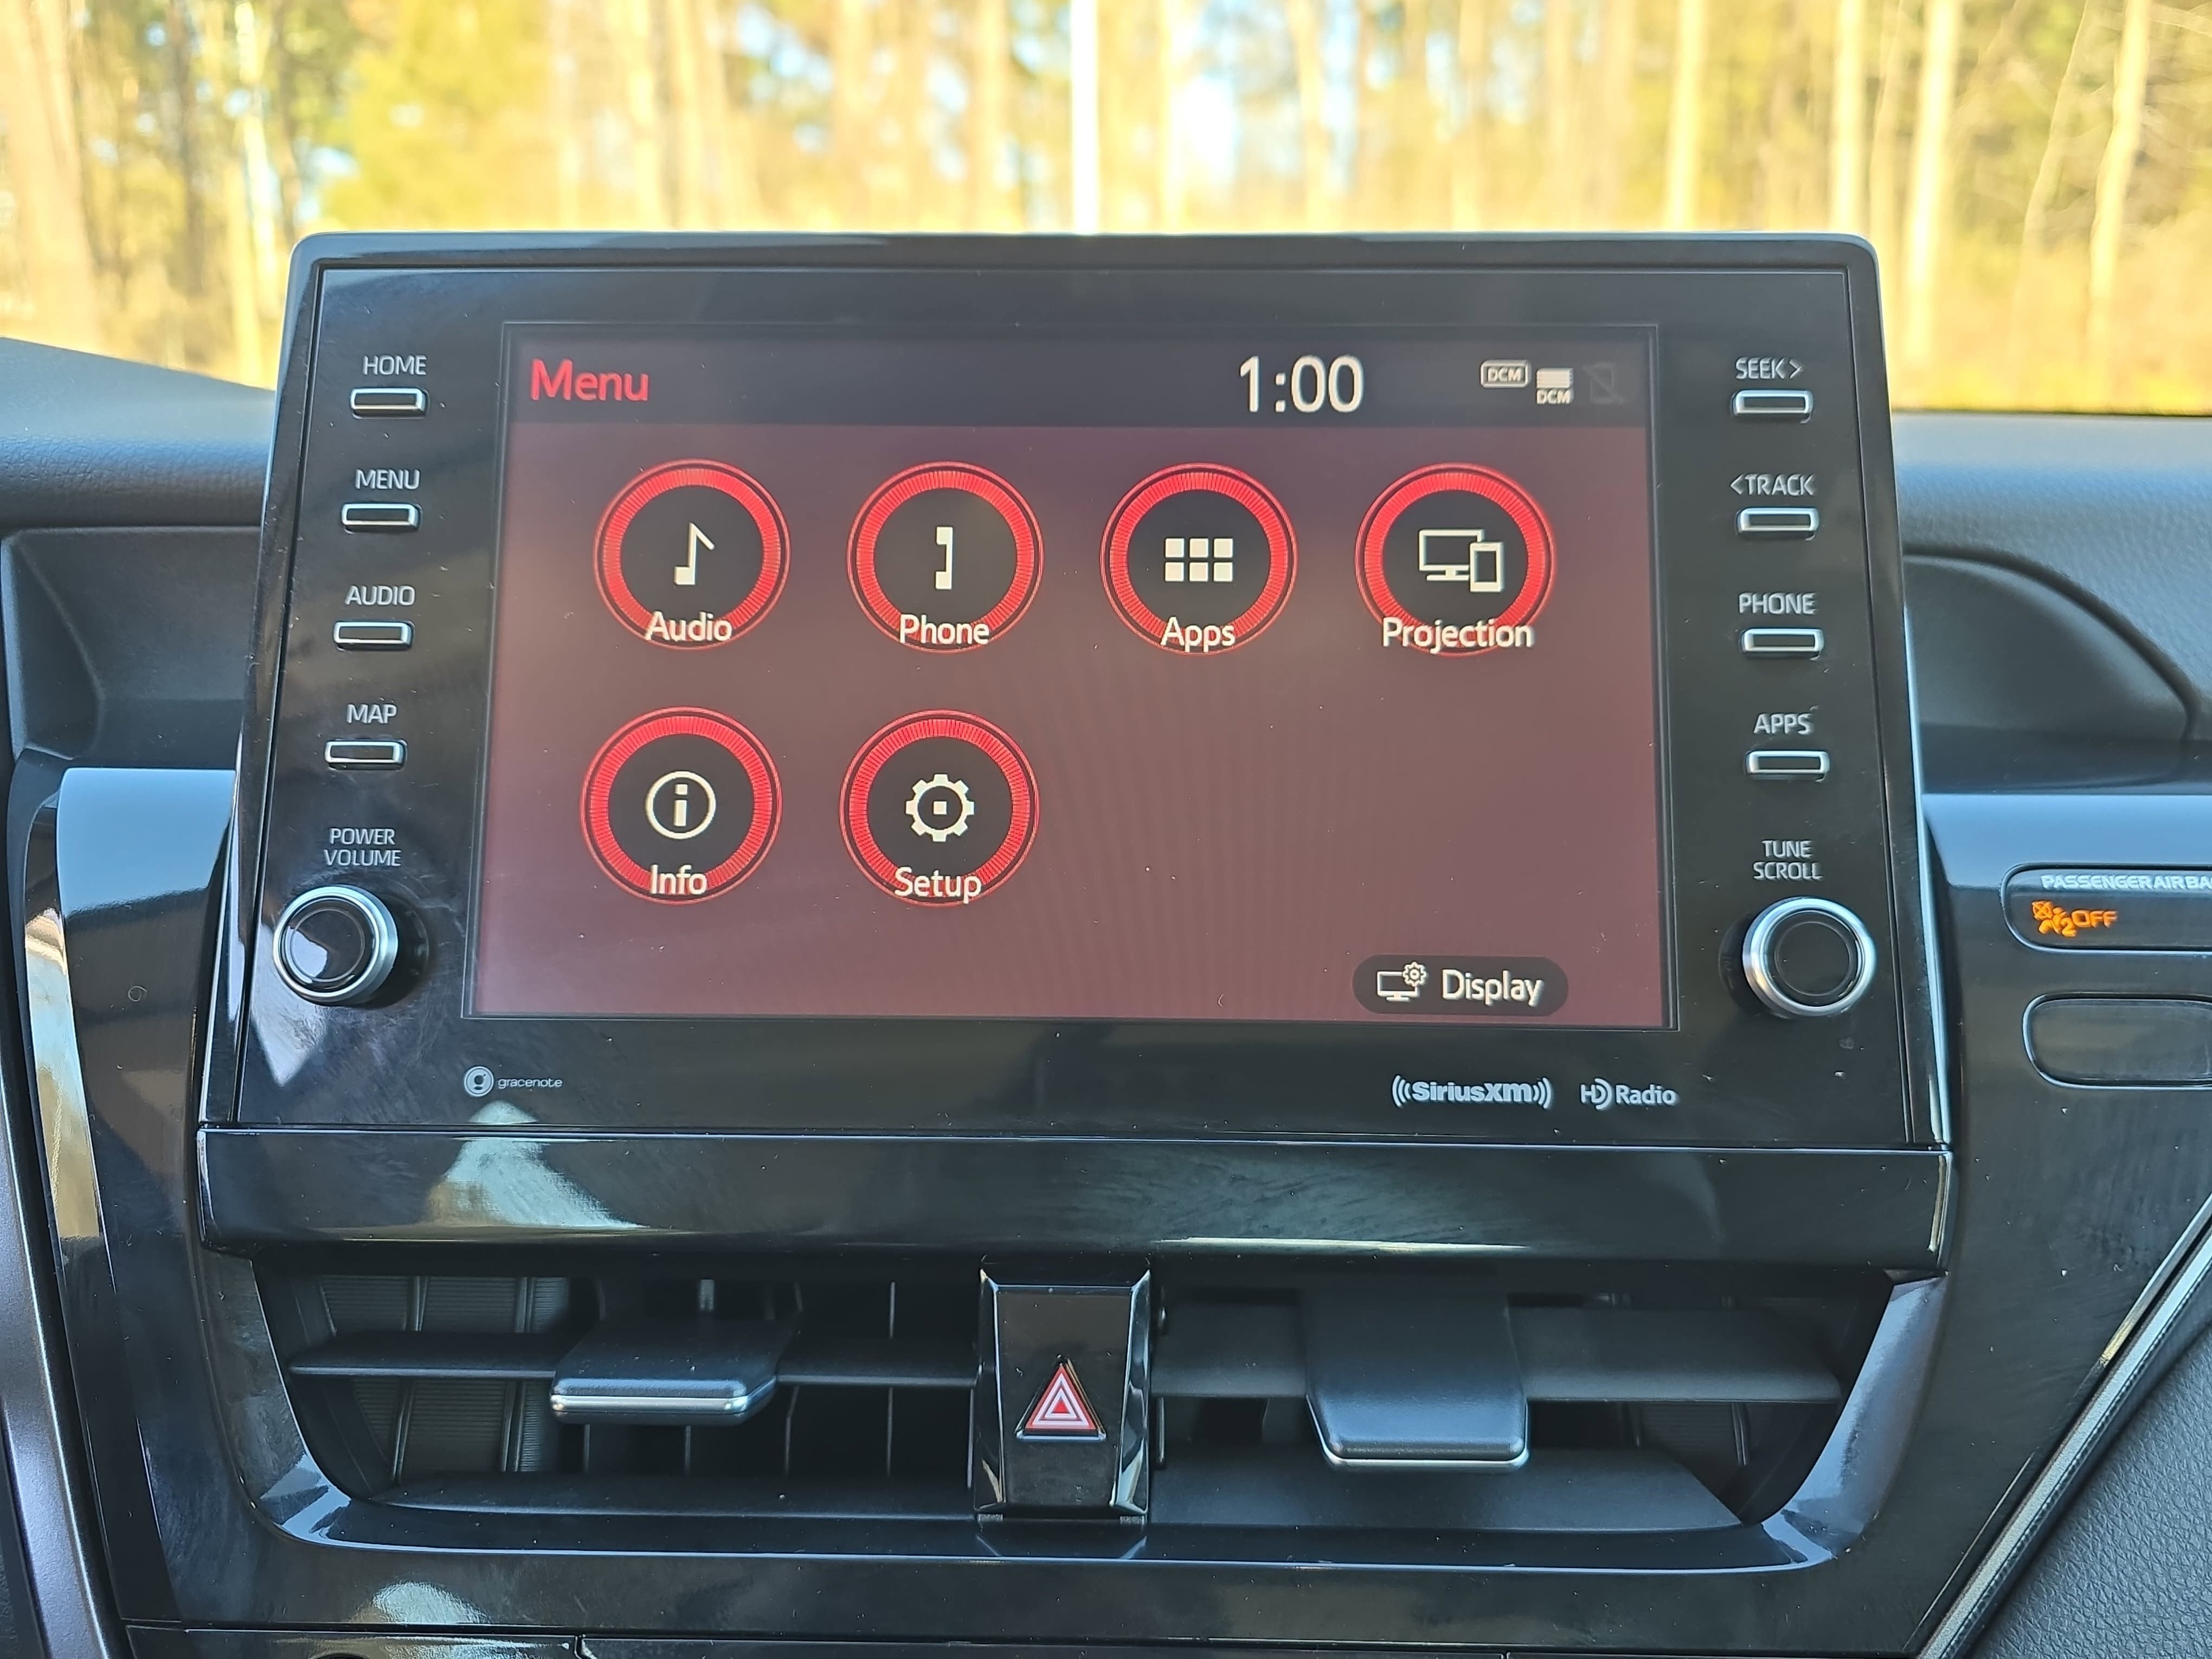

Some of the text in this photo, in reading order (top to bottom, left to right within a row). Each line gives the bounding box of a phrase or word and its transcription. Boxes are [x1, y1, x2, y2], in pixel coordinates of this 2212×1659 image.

[362, 355, 427, 375] HOME
[1488, 368, 1523, 382] DCM
[531, 358, 648, 401] Menu
[1240, 355, 1364, 413] 1:00
[1536, 389, 1573, 404] DCM
[355, 470, 421, 489] MENU
[345, 586, 416, 606] AUDIO
[1738, 593, 1816, 615] PHONE
[645, 610, 732, 642] Audio
[899, 614, 990, 645] Phone
[1160, 616, 1236, 653] Apps
[1382, 617, 1534, 654] Projection
[346, 704, 397, 724] MAP
[1753, 713, 1814, 735] APPS
[330, 828, 395, 845] POWER
[324, 849, 402, 867] VOLUME
[1761, 840, 1814, 858] TUNE
[650, 865, 708, 896] Info
[1753, 862, 1822, 880] SCROLL
[893, 867, 981, 904] Setup
[2041, 875, 2212, 890] PASSENGER AIR BA
[2072, 910, 2118, 928] OFF
[1442, 969, 1545, 1007] Display
[498, 1078, 563, 1089] gracenote
[1616, 1084, 1677, 1106] Radio
